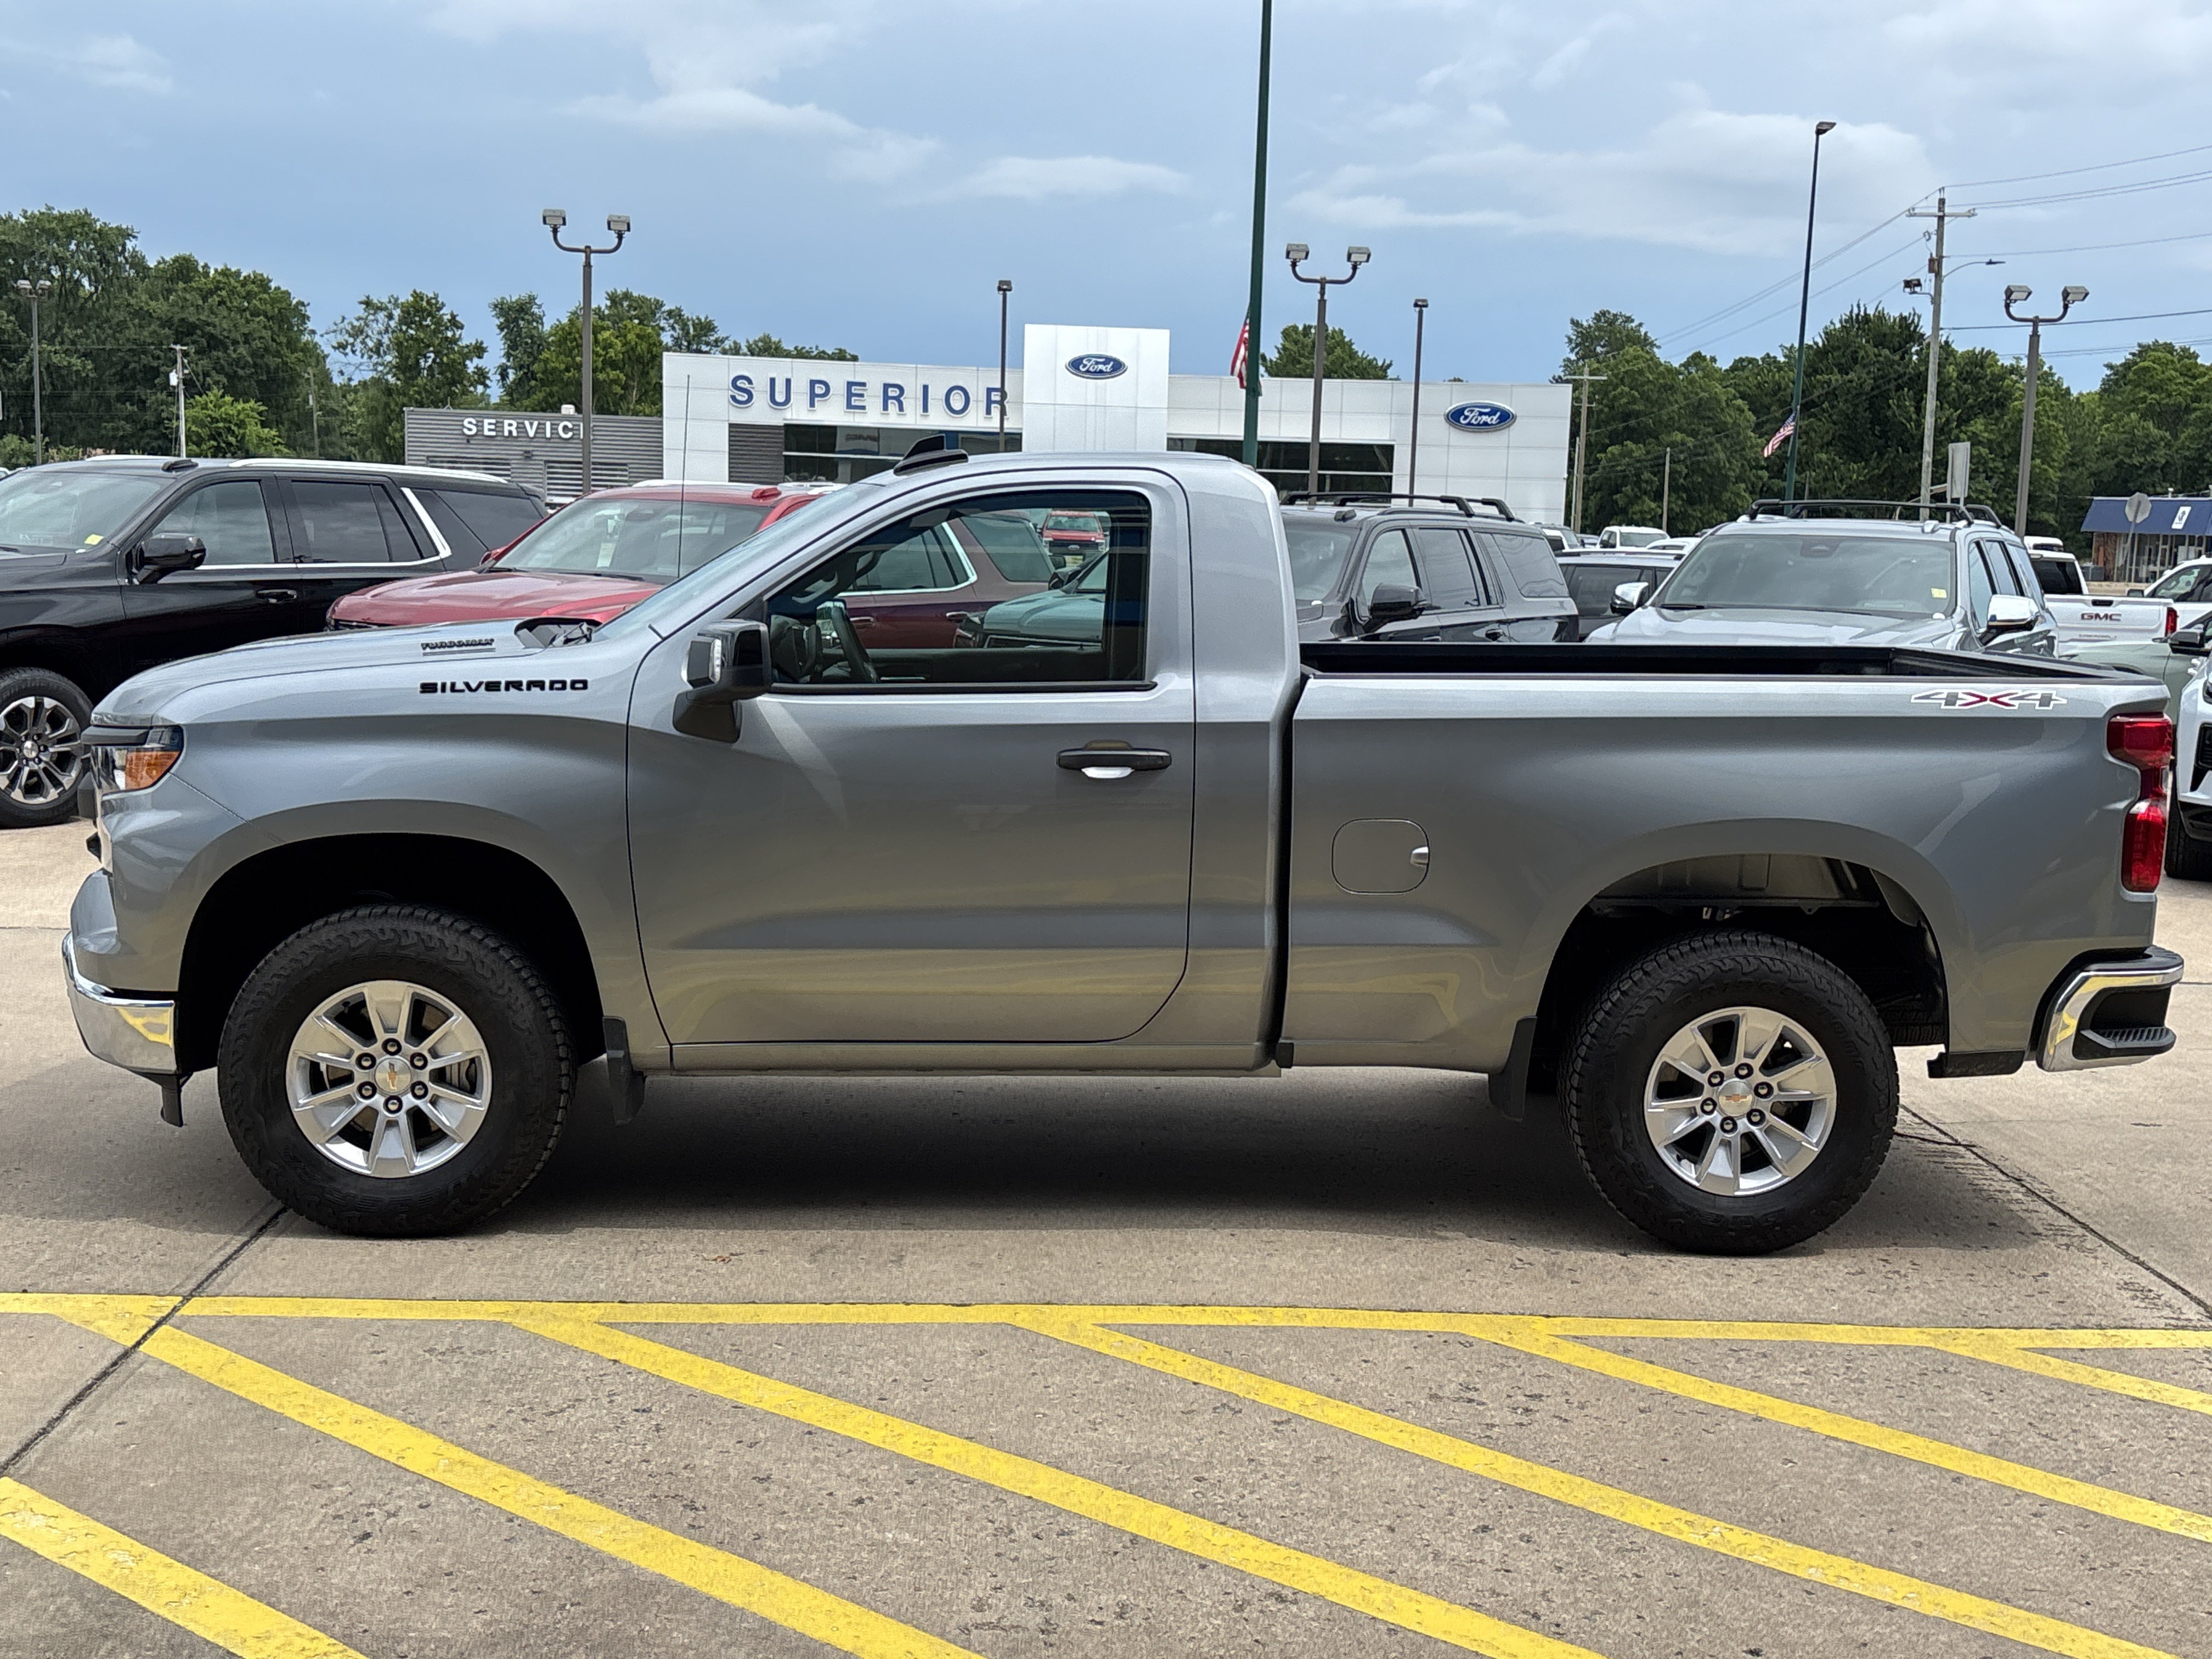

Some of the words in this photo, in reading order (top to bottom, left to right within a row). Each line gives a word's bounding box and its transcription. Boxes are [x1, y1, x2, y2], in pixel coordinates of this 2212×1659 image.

[729, 374, 1009, 419] SUPERIOR
[462, 417, 584, 439] SERVIC
[2080, 612, 2122, 622] GMC
[419, 679, 589, 694] SILVERADO
